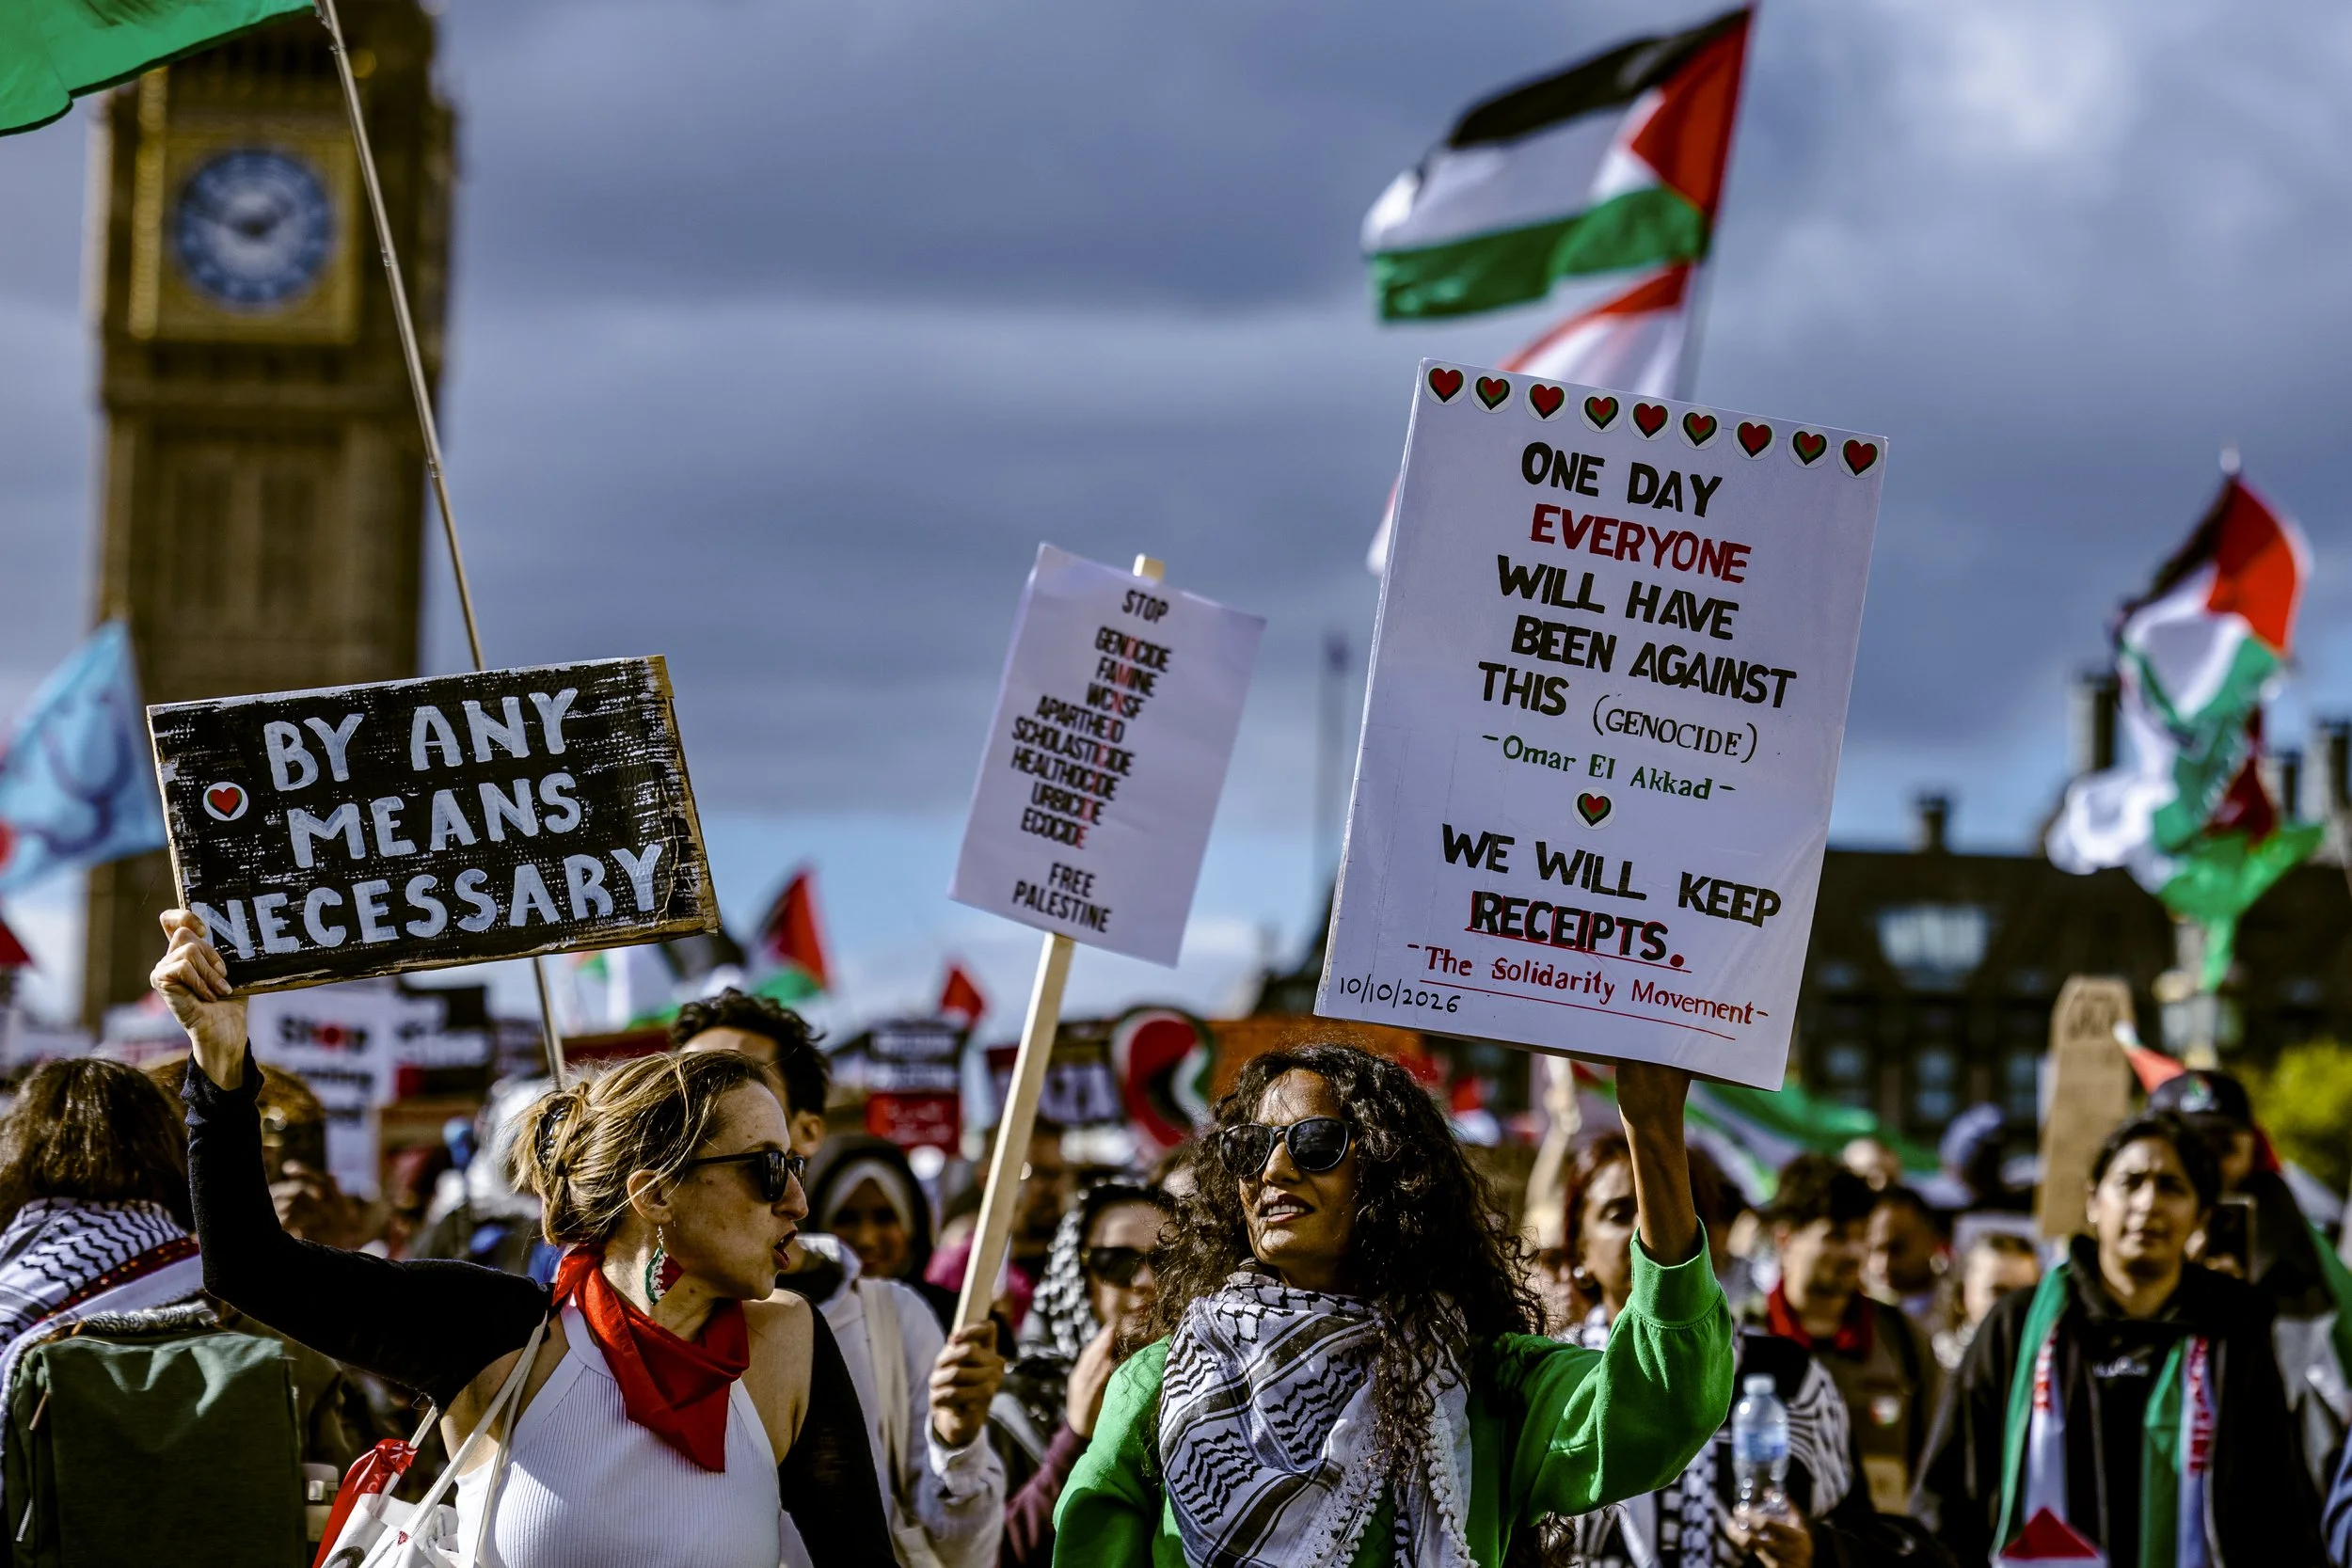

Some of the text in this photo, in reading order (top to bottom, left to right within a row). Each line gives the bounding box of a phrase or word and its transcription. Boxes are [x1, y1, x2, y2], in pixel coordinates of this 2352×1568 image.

[1521, 441, 1723, 517] ONE DAY
[1530, 503, 1752, 582] EVERYONE
[1122, 590, 1168, 624] STOP
[1497, 554, 1740, 641] WILL HAVE
[1095, 626, 1170, 673] GENOCIDE
[1511, 615, 1797, 708] BEEN AGAINST
[1096, 657, 1159, 698] FAMINE
[1036, 694, 1125, 743] APARTHEID
[1478, 660, 1757, 763] THIS (GENOCIDE)
[263, 688, 578, 791] BY ANY
[1011, 717, 1134, 776] SCHOLASTICIDE
[1011, 747, 1118, 800] HEALTHOCIDE
[1588, 753, 1613, 780] El
[287, 772, 581, 869] MEANS
[1022, 807, 1089, 849] ECOCIDE
[1031, 783, 1103, 825] URBICIDE
[190, 844, 662, 959] NECESSARY
[1048, 862, 1096, 898] FREE
[1441, 823, 1782, 928] WE WILL KEEP
[1012, 880, 1112, 933] PALESTINE
[1470, 890, 1686, 969] RECEIPTS.
[1339, 974, 1462, 1014] 10/10/2026
[1491, 957, 1615, 1005] Solidarity
